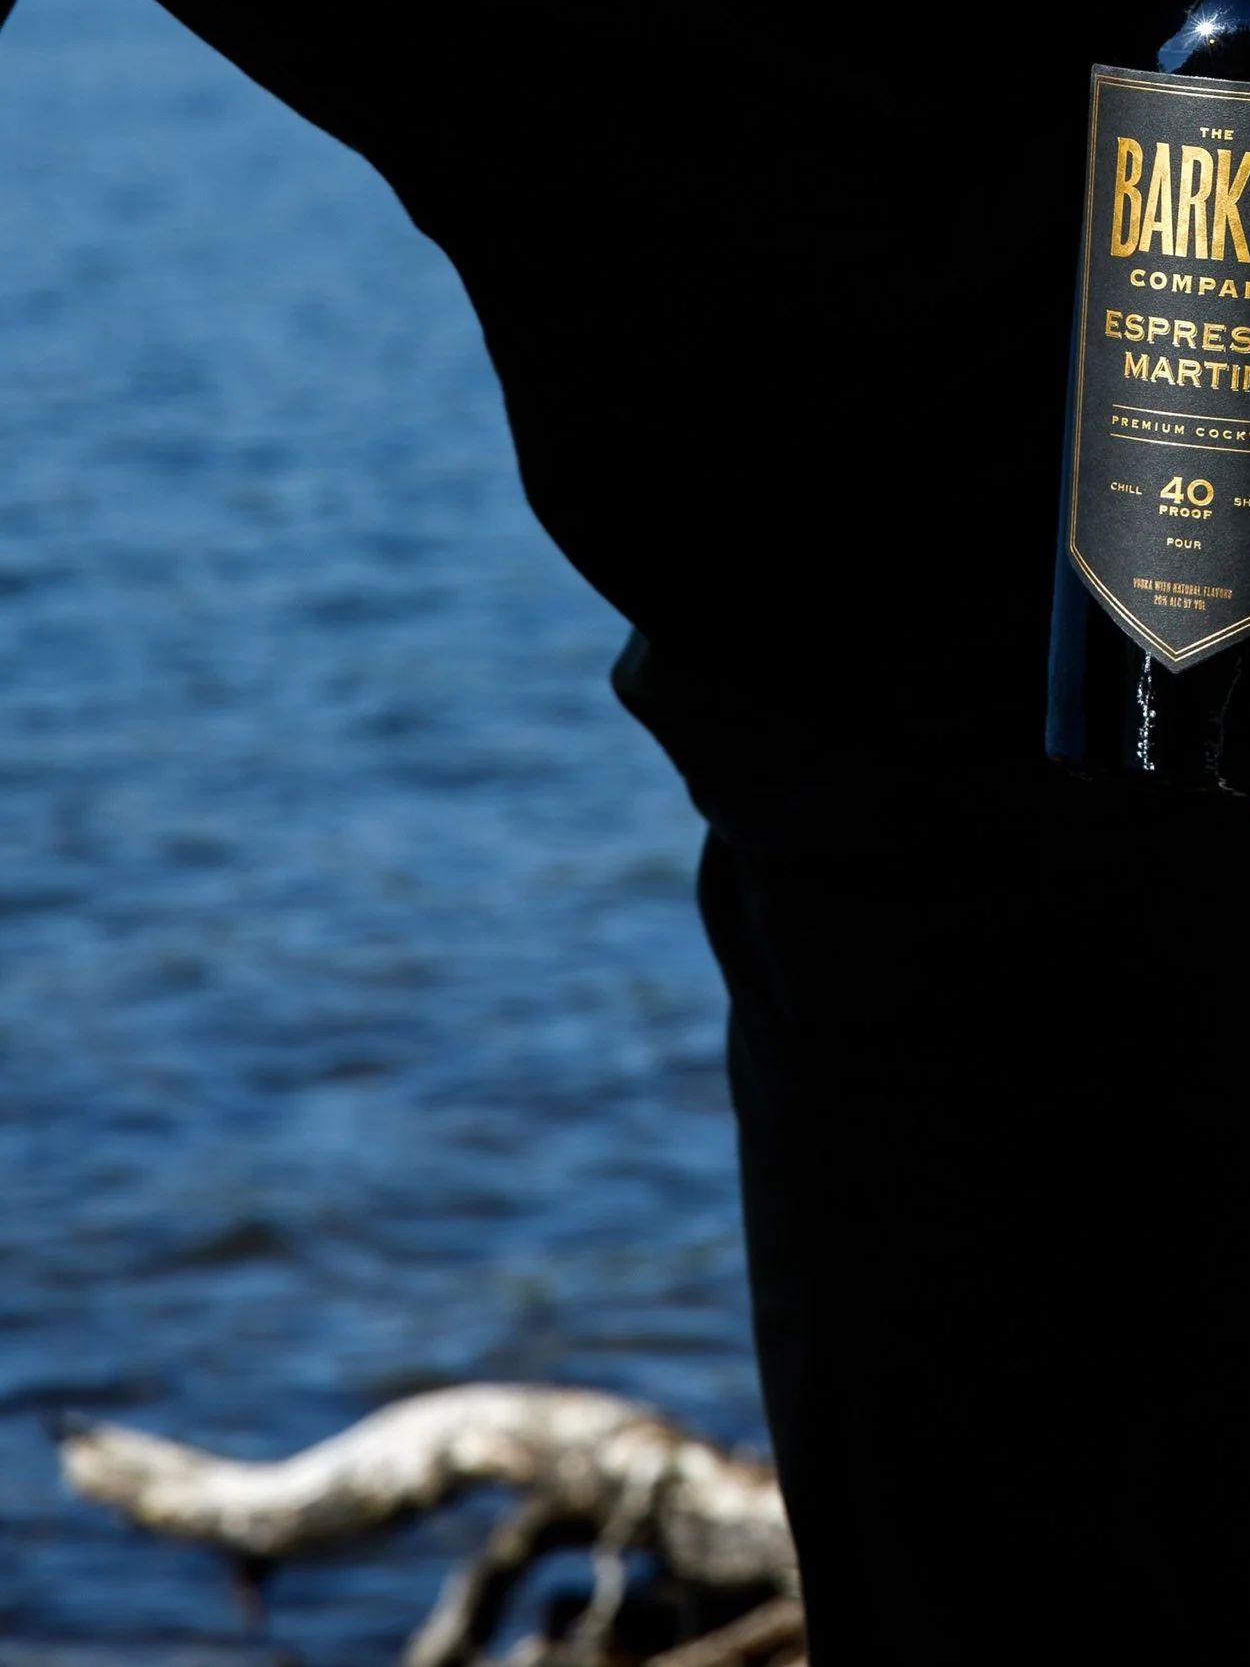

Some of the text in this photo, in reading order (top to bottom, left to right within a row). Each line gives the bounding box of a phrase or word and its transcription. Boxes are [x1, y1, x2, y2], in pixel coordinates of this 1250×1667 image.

[1200, 127, 1235, 141] THE
[1111, 414, 1185, 435] PREMIUM
[1110, 481, 1143, 495] CHILL
[1159, 476, 1215, 507] 40
[1158, 505, 1213, 520] PROOF
[1166, 537, 1203, 550] POUR
